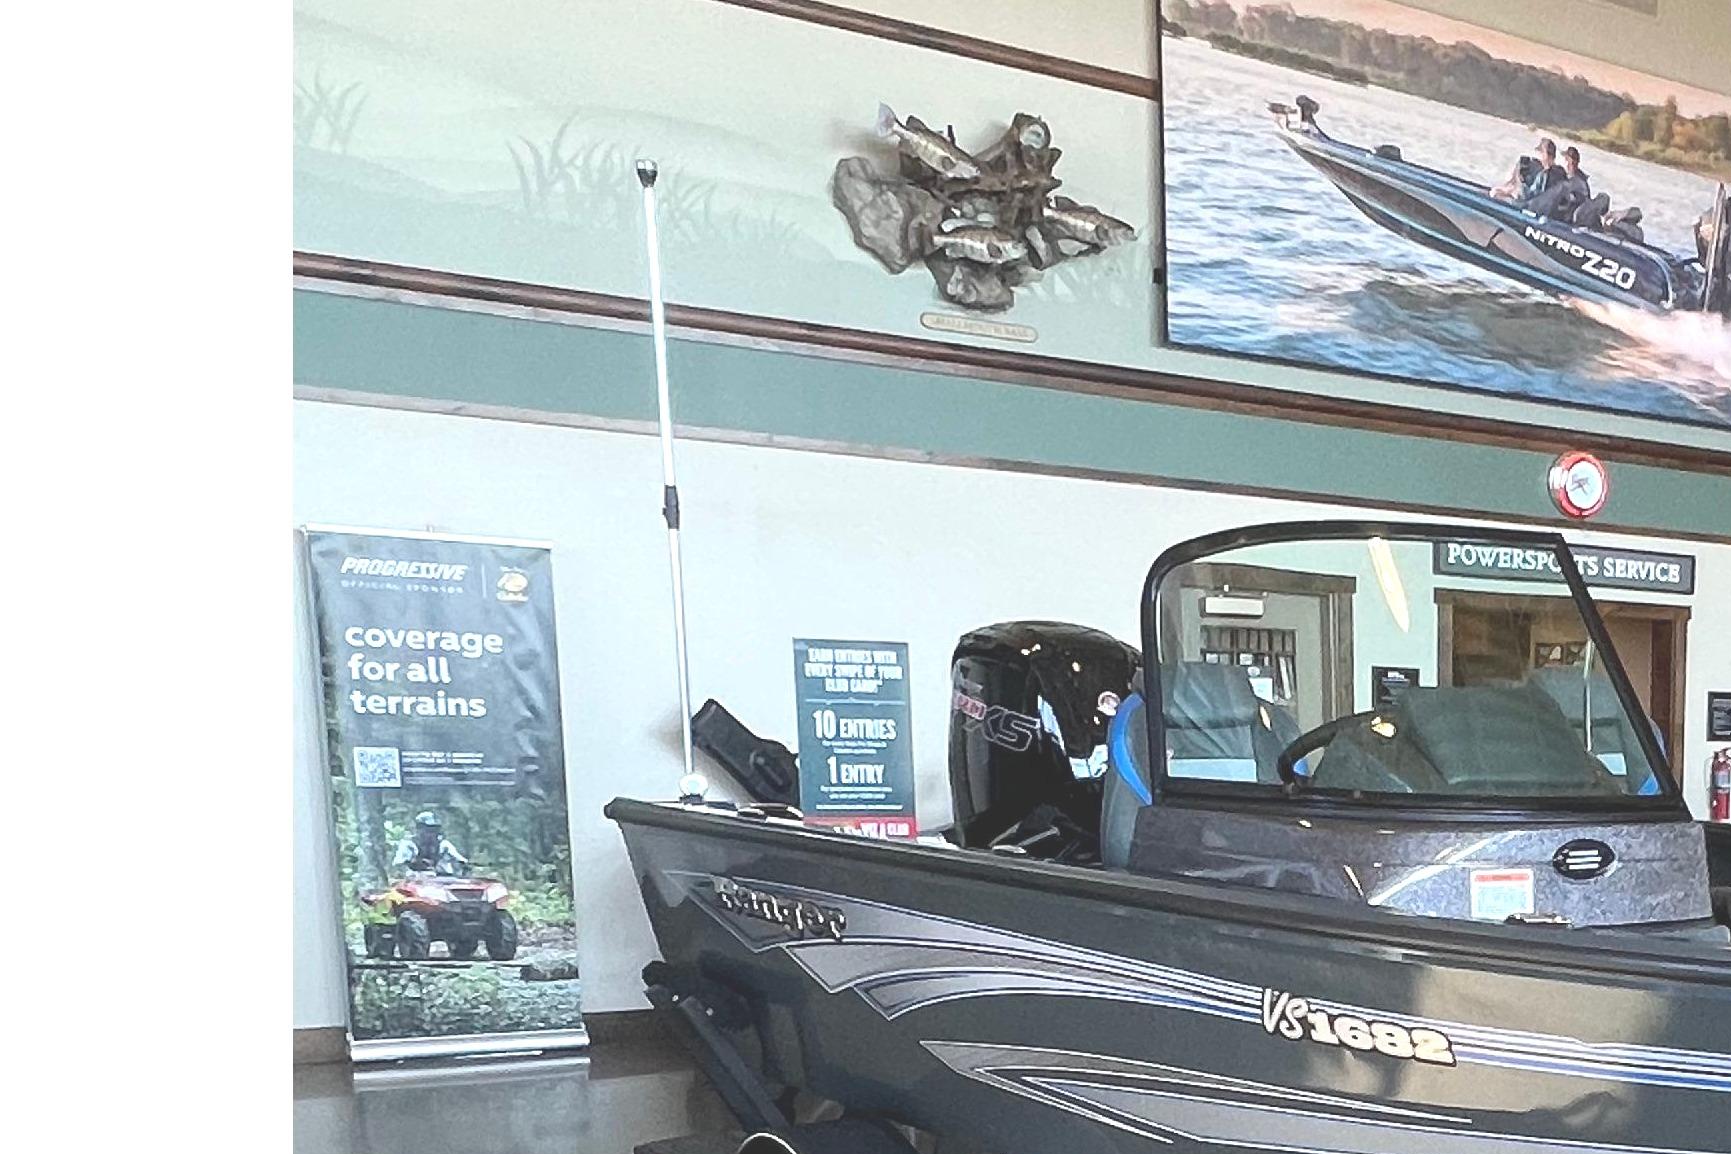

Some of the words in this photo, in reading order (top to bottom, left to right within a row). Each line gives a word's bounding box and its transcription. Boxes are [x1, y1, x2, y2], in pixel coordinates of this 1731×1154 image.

[1525, 226, 1585, 258] NITRO
[1582, 250, 1636, 290] Z20
[341, 556, 468, 582] PROGRESSIVE
[1447, 543, 1599, 576] POWERSPOTS
[1603, 557, 1681, 584] SERVICE
[345, 626, 503, 658] coverage
[347, 653, 400, 681] for
[406, 656, 452, 683] all
[350, 690, 487, 718] terrains
[813, 709, 837, 739] 10
[840, 718, 897, 740] ENTRIES
[827, 756, 838, 784] 1
[840, 764, 885, 784] ENTRY
